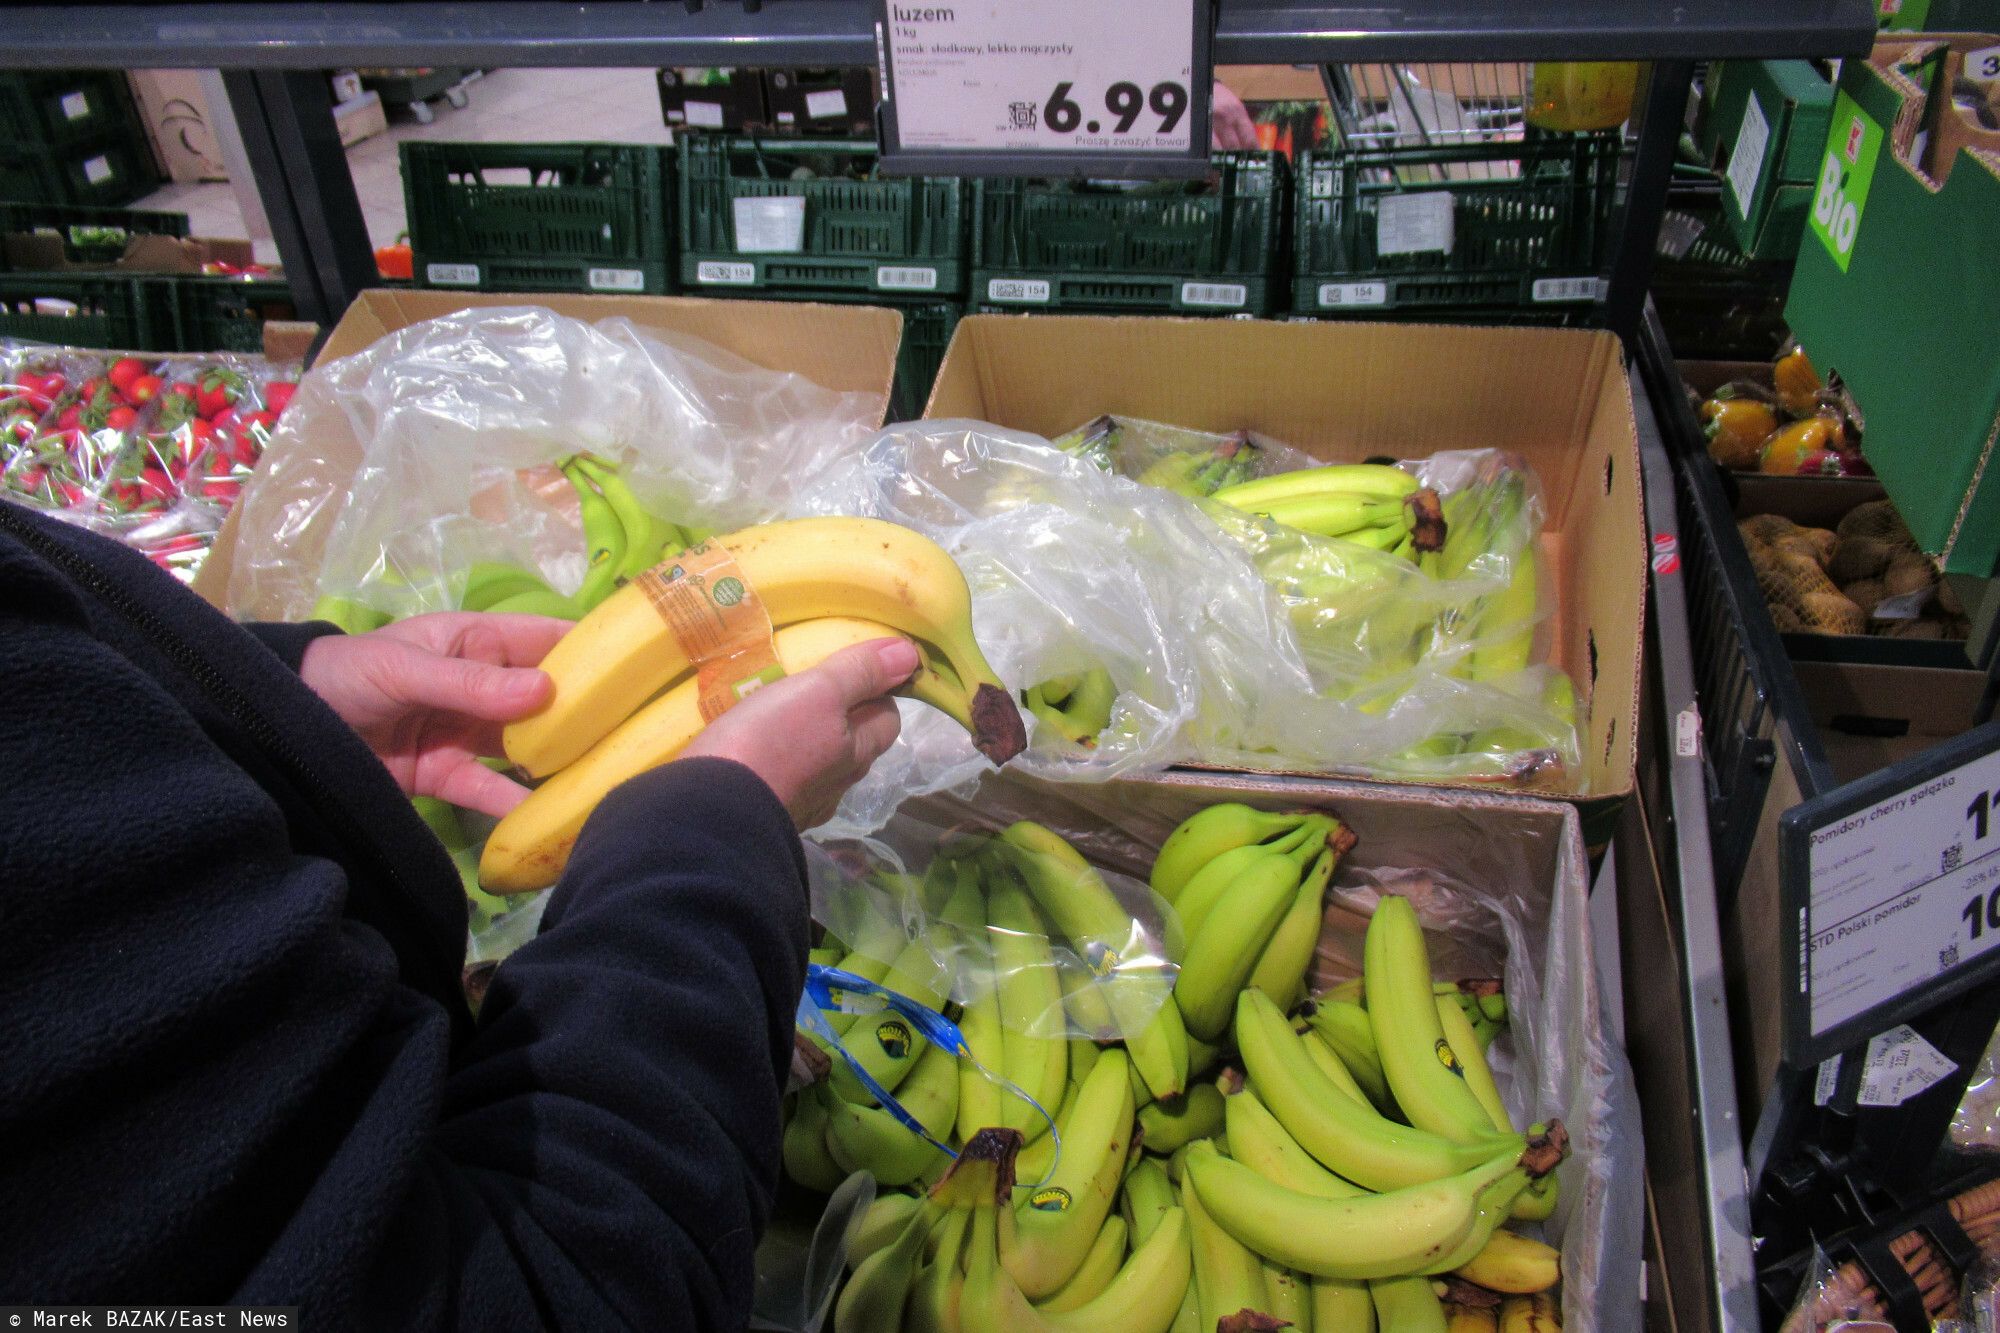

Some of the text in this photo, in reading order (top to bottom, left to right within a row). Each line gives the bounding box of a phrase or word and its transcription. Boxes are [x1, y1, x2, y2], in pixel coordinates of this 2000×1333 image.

[894, 4, 954, 21] luzem
[903, 27, 917, 38] kg
[988, 43, 1016, 54] lekko
[1044, 81, 1188, 133] 6.99
[1155, 136, 1189, 146] towar
[1028, 286, 1046, 295] 154
[1810, 776, 1956, 847] Pomidory cherry gałązka
[1809, 893, 1922, 953] STD Polski pomidor
